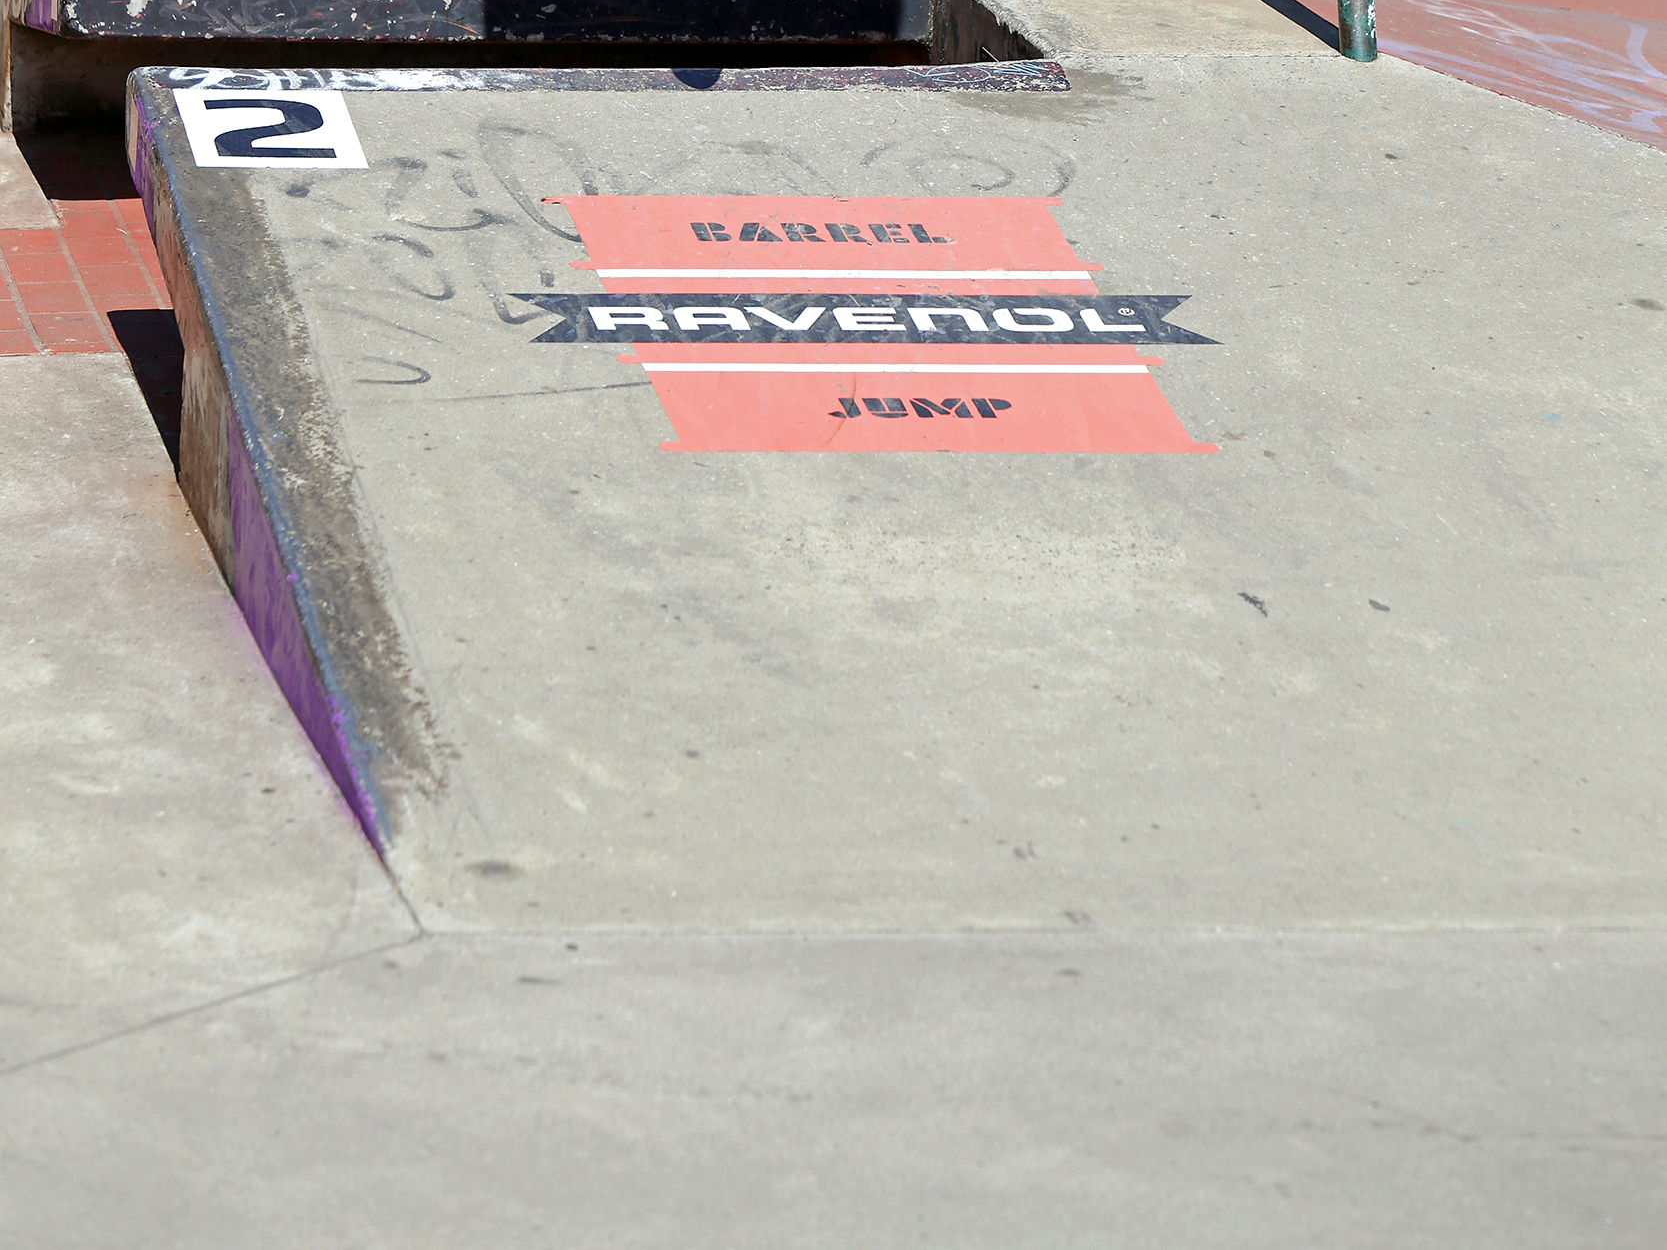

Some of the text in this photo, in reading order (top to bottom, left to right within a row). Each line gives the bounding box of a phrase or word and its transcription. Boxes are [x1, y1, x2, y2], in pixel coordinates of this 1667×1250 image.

[203, 99, 337, 158] 2
[691, 222, 953, 244] BARREL
[828, 398, 1012, 418] JUMP
